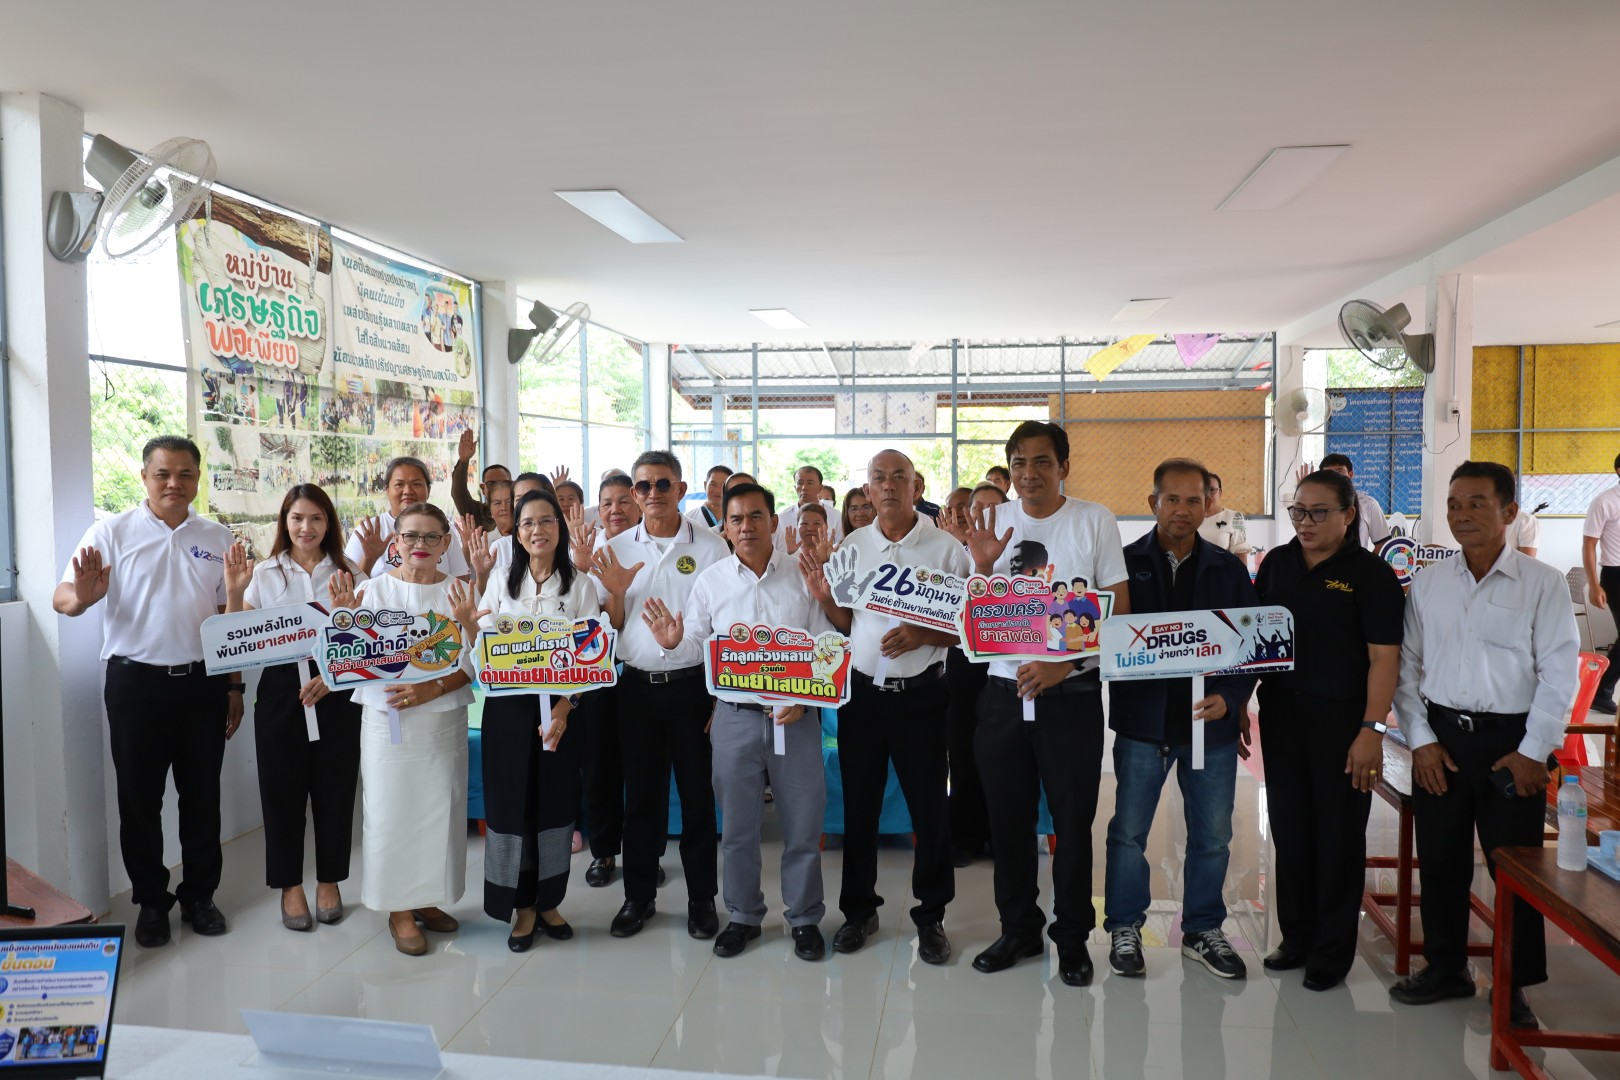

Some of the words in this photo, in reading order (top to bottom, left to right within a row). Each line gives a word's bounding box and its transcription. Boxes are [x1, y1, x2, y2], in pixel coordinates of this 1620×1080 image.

[226, 252, 293, 290] หมู่บ้าน
[200, 283, 318, 340] เศรษฐกิจ
[205, 320, 297, 365] พอเพียง
[873, 563, 915, 595] 26
[915, 583, 962, 605] มิถุนาย
[972, 598, 1046, 618] ครอบครัว
[226, 615, 303, 641] รวมพลังไทย
[980, 628, 1043, 643] ยาเสพติด
[1155, 625, 1169, 633] SAY
[216, 627, 317, 659] พ้นภัยยาเสพติด
[326, 639, 365, 660] คิดดี
[372, 633, 408, 653] ทำดี
[425, 631, 446, 647] DRUGS
[492, 645, 508, 655] คน
[511, 635, 569, 654] พช.โคราช
[1147, 629, 1207, 650] DRUGS
[328, 653, 411, 673] ต่อต้านยาเสพติด
[516, 654, 544, 664] พร้อมใจ
[720, 647, 814, 664] รักลูกห่วงหลาน
[1115, 647, 1156, 668] ไม่เริ่ม
[1158, 646, 1194, 660] ง่ายกว่า
[1196, 642, 1222, 658] เลิก
[480, 664, 613, 684] ต้านภัยยาเสพติด
[760, 664, 786, 672] ร่วมกัน
[718, 667, 837, 698] ต้านยาเสพติด
